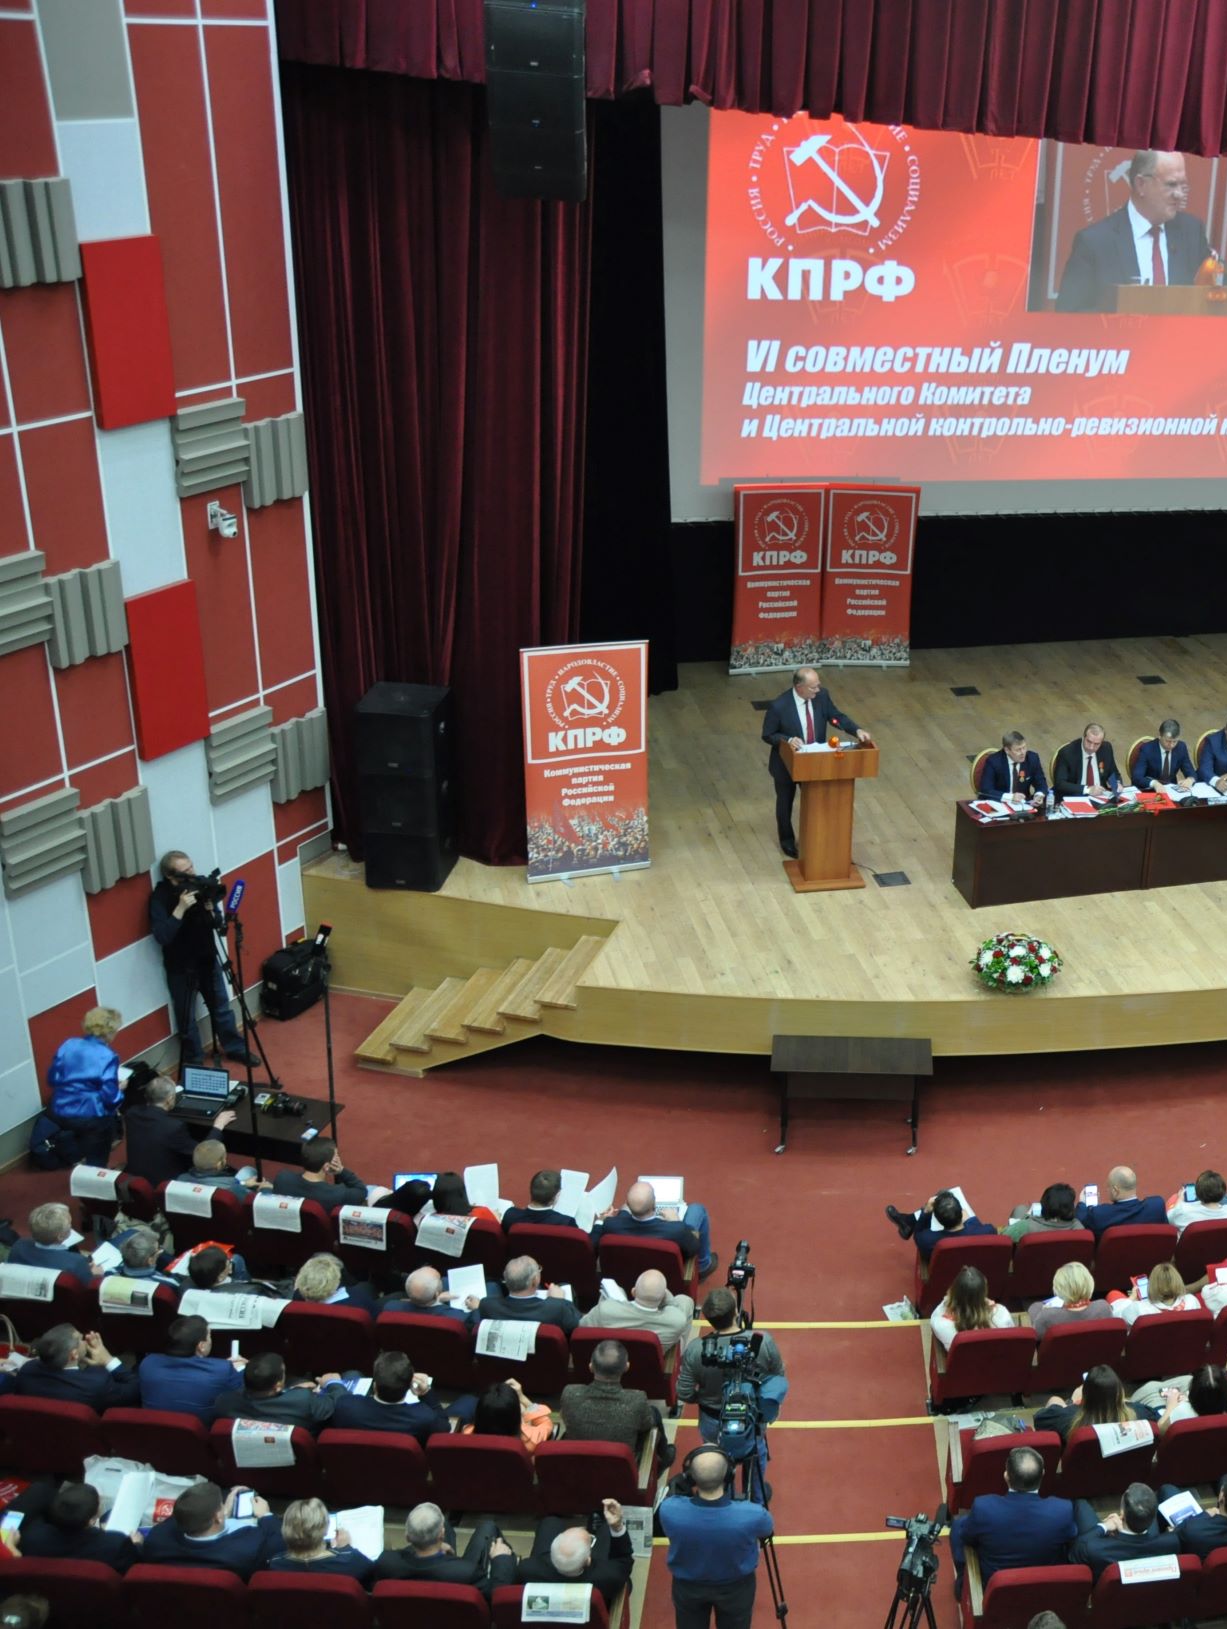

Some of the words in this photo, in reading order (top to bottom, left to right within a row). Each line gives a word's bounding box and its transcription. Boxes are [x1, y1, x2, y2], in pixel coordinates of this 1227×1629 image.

[749, 133, 775, 169] ТРУД
[877, 155, 921, 251] СОЦИАЛИЗМ
[748, 188, 785, 247] РОССИЯ
[747, 257, 916, 302] КПРФ
[746, 340, 781, 373] VI
[785, 341, 1003, 375] совместный
[1006, 343, 1130, 377] Пленум
[742, 382, 915, 409] Центрального
[918, 382, 1032, 406] Комитета
[741, 418, 759, 438] и
[762, 413, 926, 440] Центральной
[928, 413, 1218, 438] контрольно-ревизионной
[752, 550, 808, 566] КПРФ
[841, 550, 897, 565] КПРФ
[548, 726, 627, 753] КПРФ
[543, 762, 632, 778] Коммунистическая
[571, 775, 604, 785] партия
[561, 783, 615, 797] Российской
[562, 795, 614, 807] Федерации
[229, 885, 243, 909] РОССИЯ
